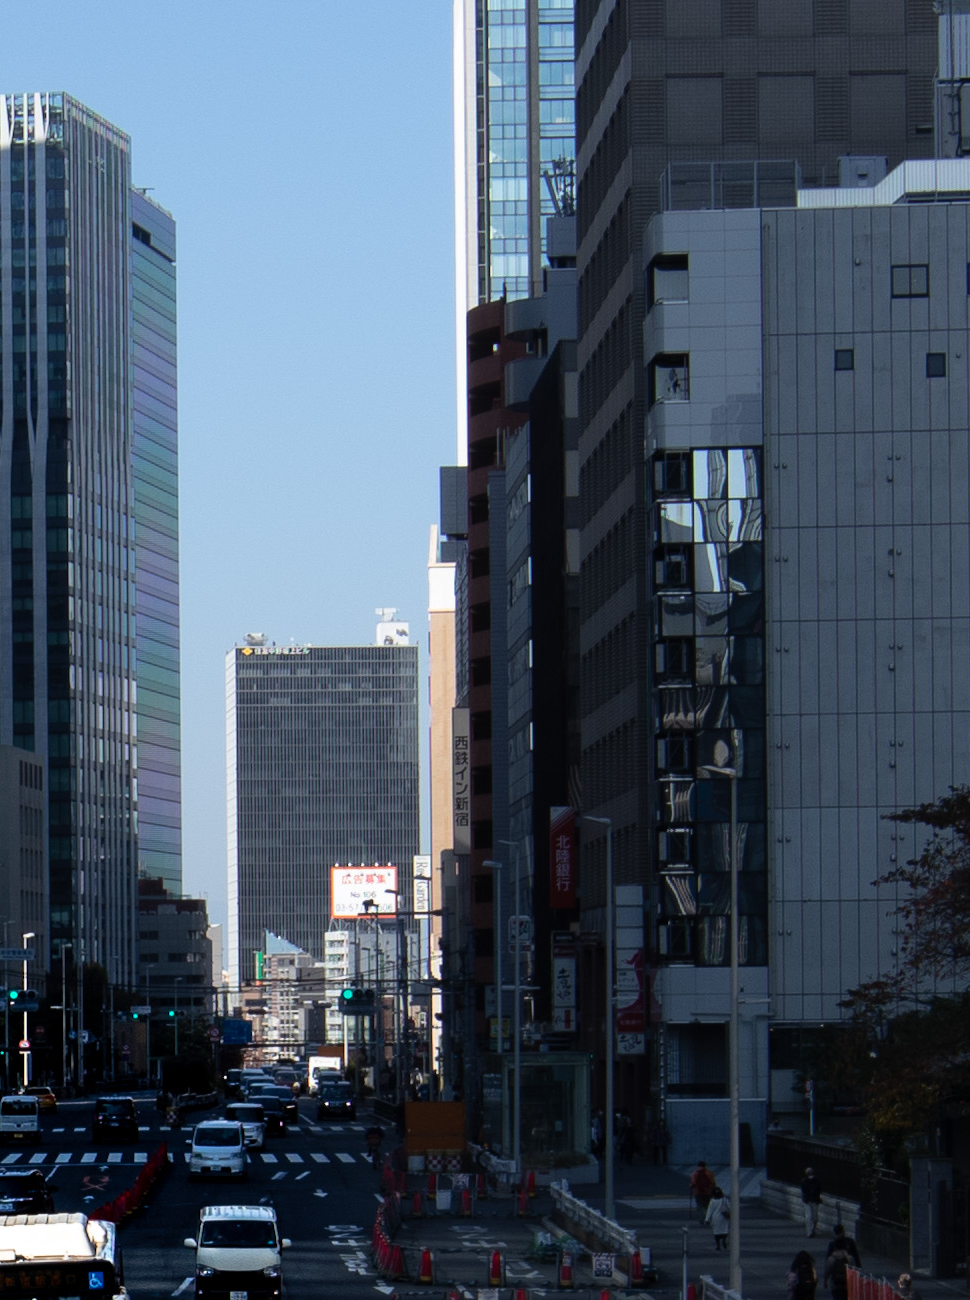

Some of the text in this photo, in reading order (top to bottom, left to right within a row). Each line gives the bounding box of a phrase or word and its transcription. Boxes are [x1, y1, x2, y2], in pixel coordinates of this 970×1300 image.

[454, 735, 469, 828] 西鉄イン新宿
[555, 835, 571, 892] 北陸銀行
